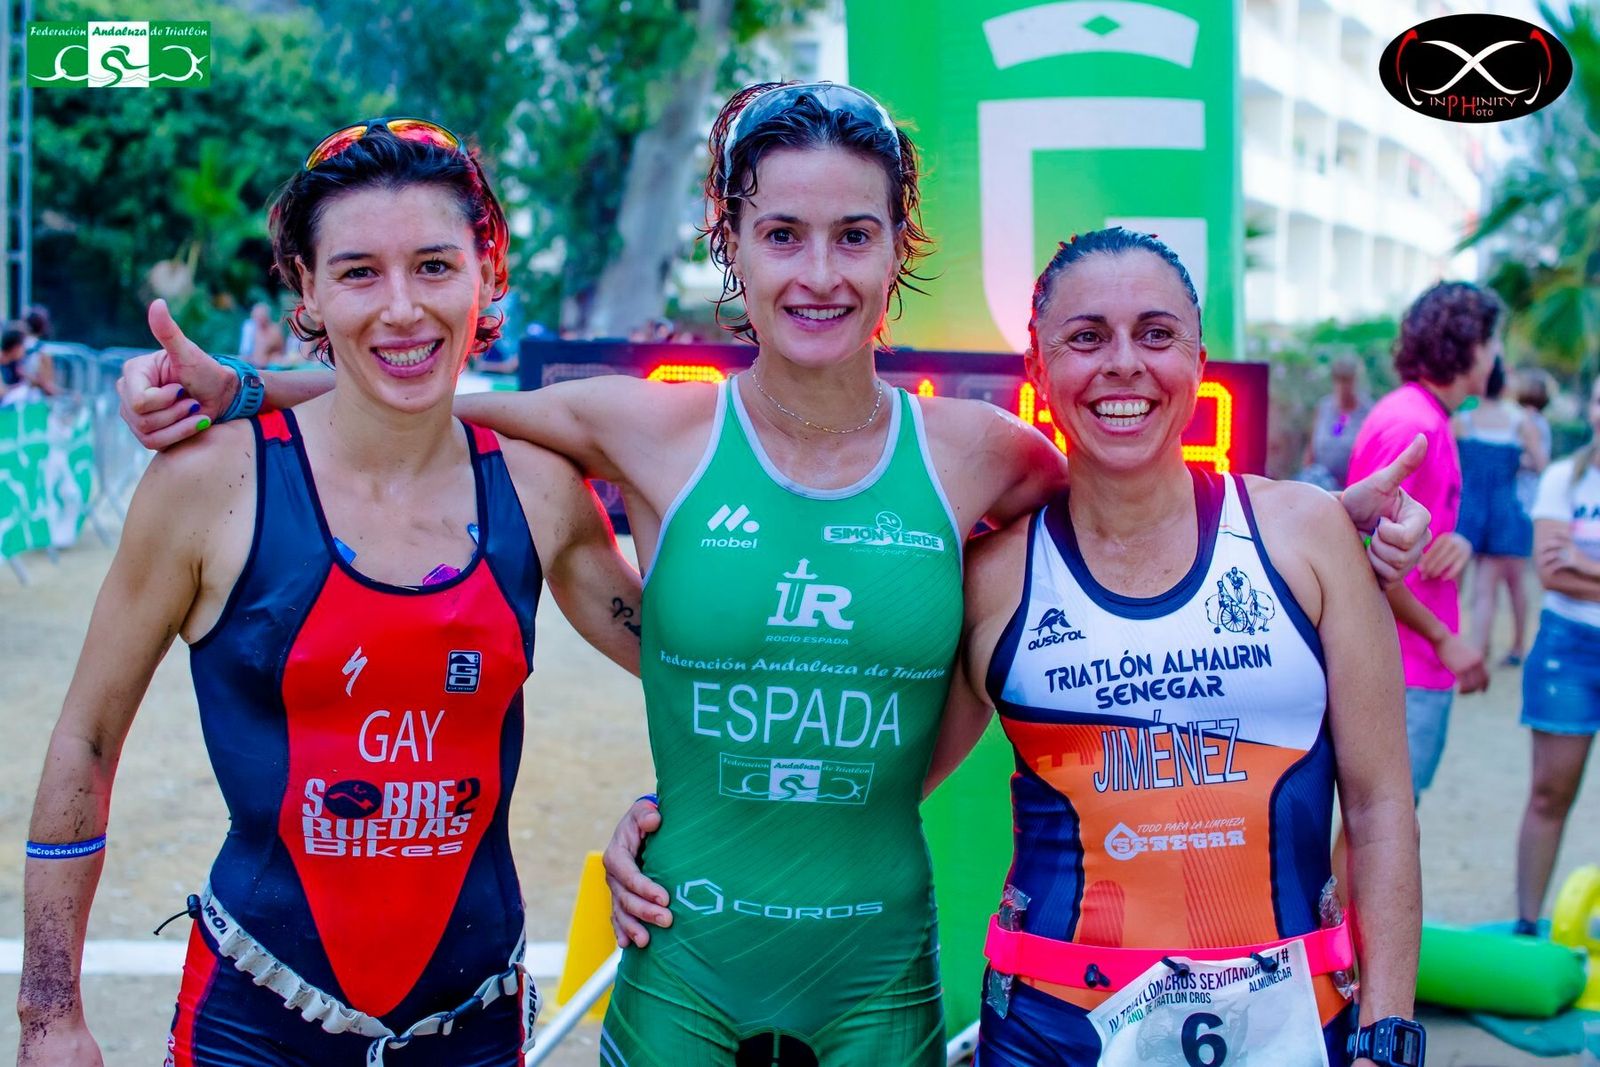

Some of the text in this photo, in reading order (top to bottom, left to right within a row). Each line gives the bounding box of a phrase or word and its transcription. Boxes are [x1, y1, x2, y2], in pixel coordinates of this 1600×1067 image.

[701, 537, 758, 550] mobel
[803, 636, 849, 646] ESPADA
[1028, 630, 1086, 650] austral
[660, 650, 747, 671] Federación
[751, 658, 858, 676] Andaluza
[864, 664, 889, 677] de
[1044, 643, 1272, 693] TRIATLÓN ALHAURIN
[1095, 675, 1225, 710] SENEGAR
[693, 681, 901, 749] ESPADA
[358, 709, 445, 763] GAY
[1093, 708, 1248, 793] JIMÉNEZ
[773, 762, 820, 771] Andaluza
[302, 813, 472, 840] RUEDAS
[305, 837, 464, 858] Bikes
[1112, 830, 1246, 853] SENEGAR
[734, 899, 883, 919] COROS
[1165, 972, 1197, 991] CROS
[1189, 991, 1212, 1004] CROS
[1181, 1012, 1228, 1067] 6
